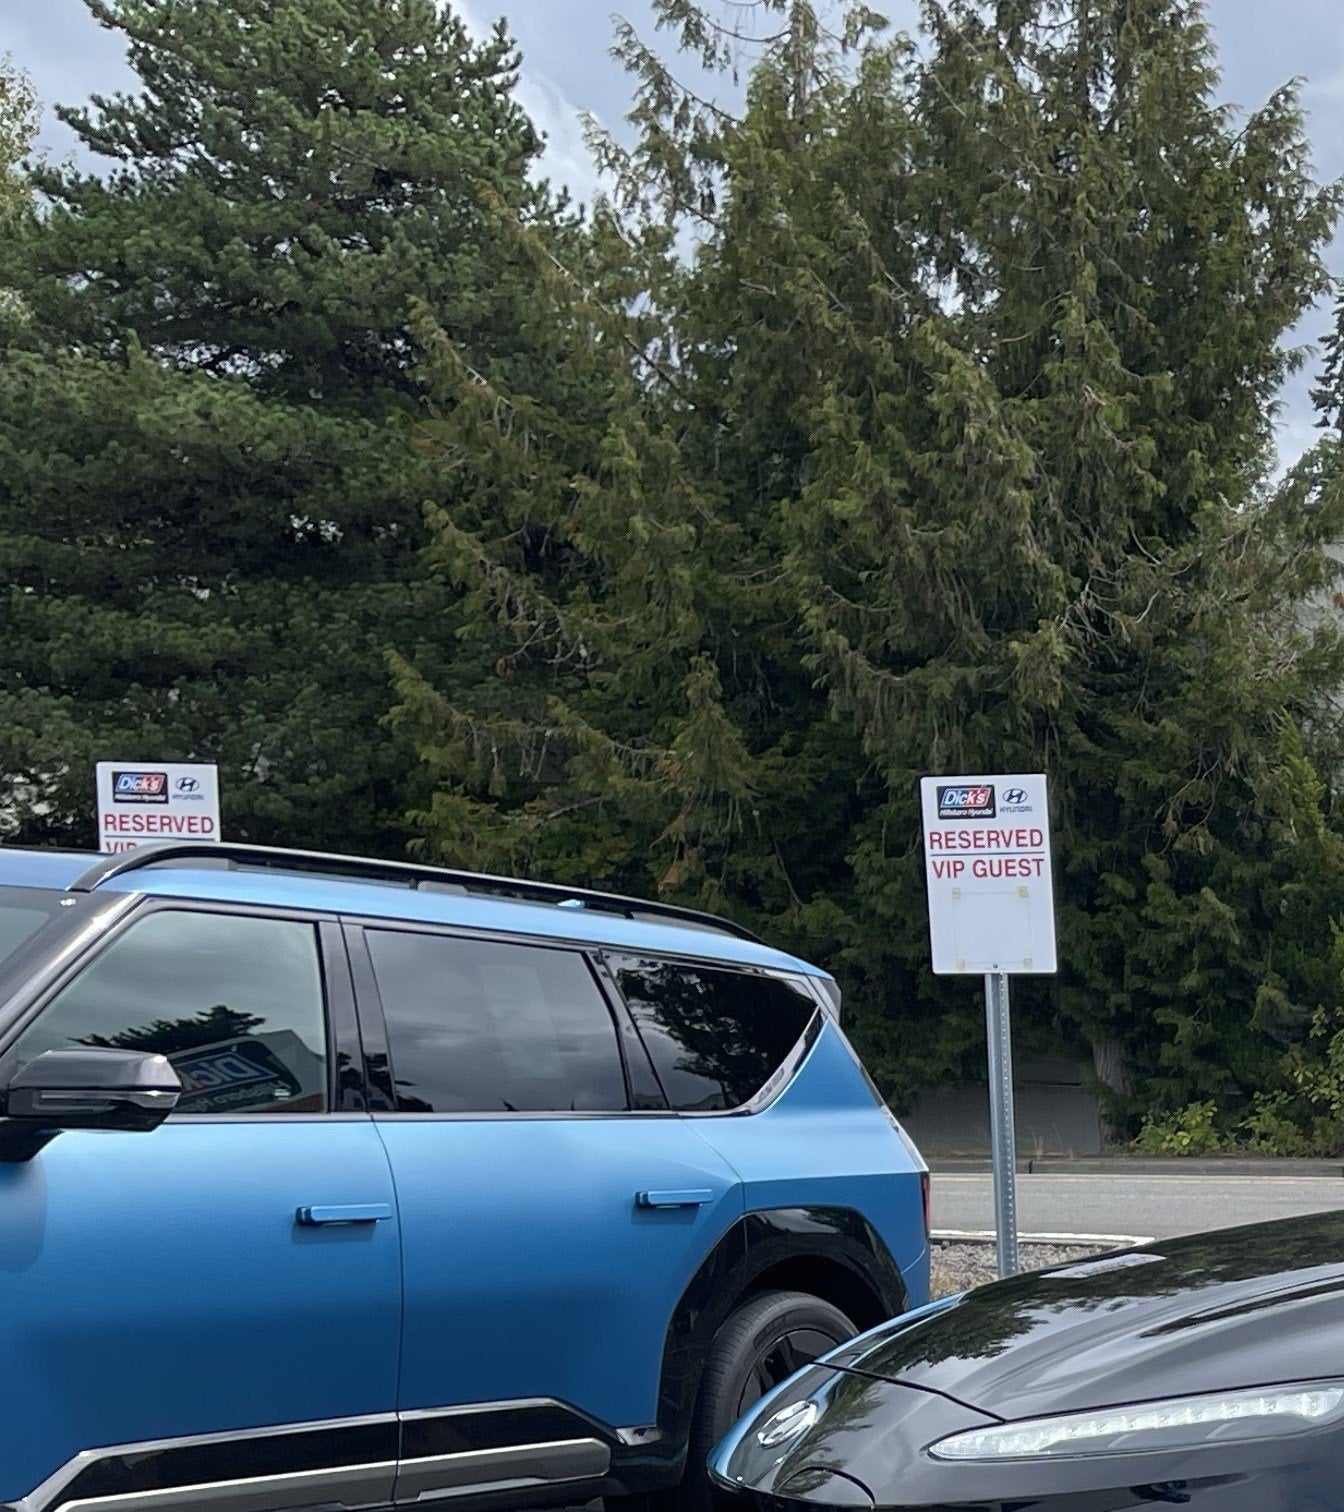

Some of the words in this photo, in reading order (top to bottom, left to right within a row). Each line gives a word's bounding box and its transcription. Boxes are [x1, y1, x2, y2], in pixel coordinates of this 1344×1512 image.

[104, 813, 215, 834] RESERVED
[929, 828, 1044, 850] RESERVED
[932, 860, 964, 879] VIP
[972, 858, 1045, 878] GUEST
